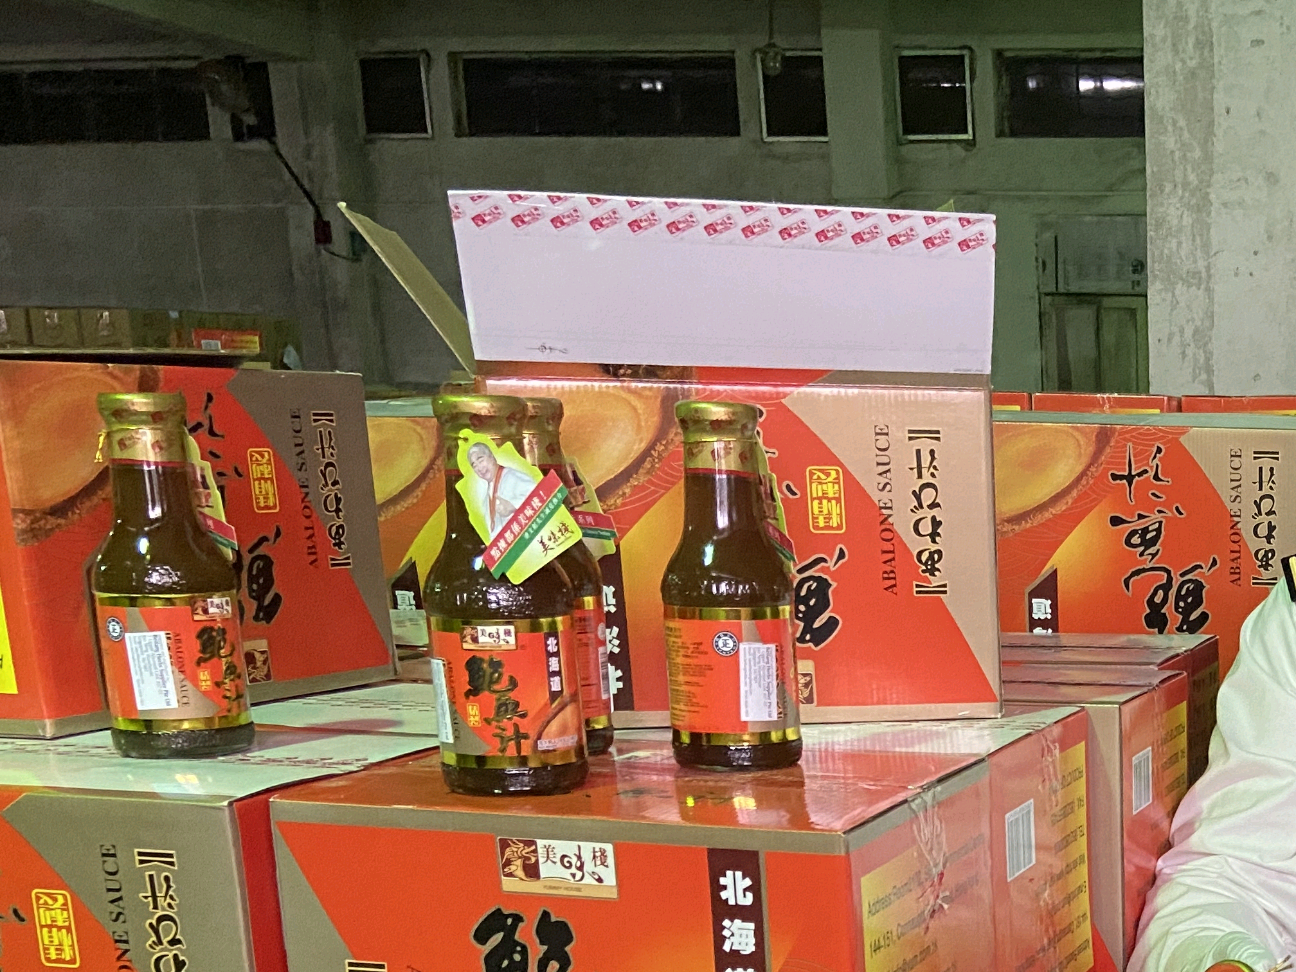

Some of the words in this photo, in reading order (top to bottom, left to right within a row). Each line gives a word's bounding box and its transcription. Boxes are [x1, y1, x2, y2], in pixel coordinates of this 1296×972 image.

[290, 408, 308, 474] SAUCE
[874, 424, 893, 493] SAUCE
[811, 469, 842, 528] 精製
[1229, 448, 1242, 508] SAUCE
[299, 480, 319, 569] ABALONE
[877, 498, 898, 596] ABALONE
[1229, 510, 1242, 587] ABALONE
[546, 636, 561, 692] 北海道
[101, 844, 127, 924] SAUCE
[36, 892, 73, 962] 精製
